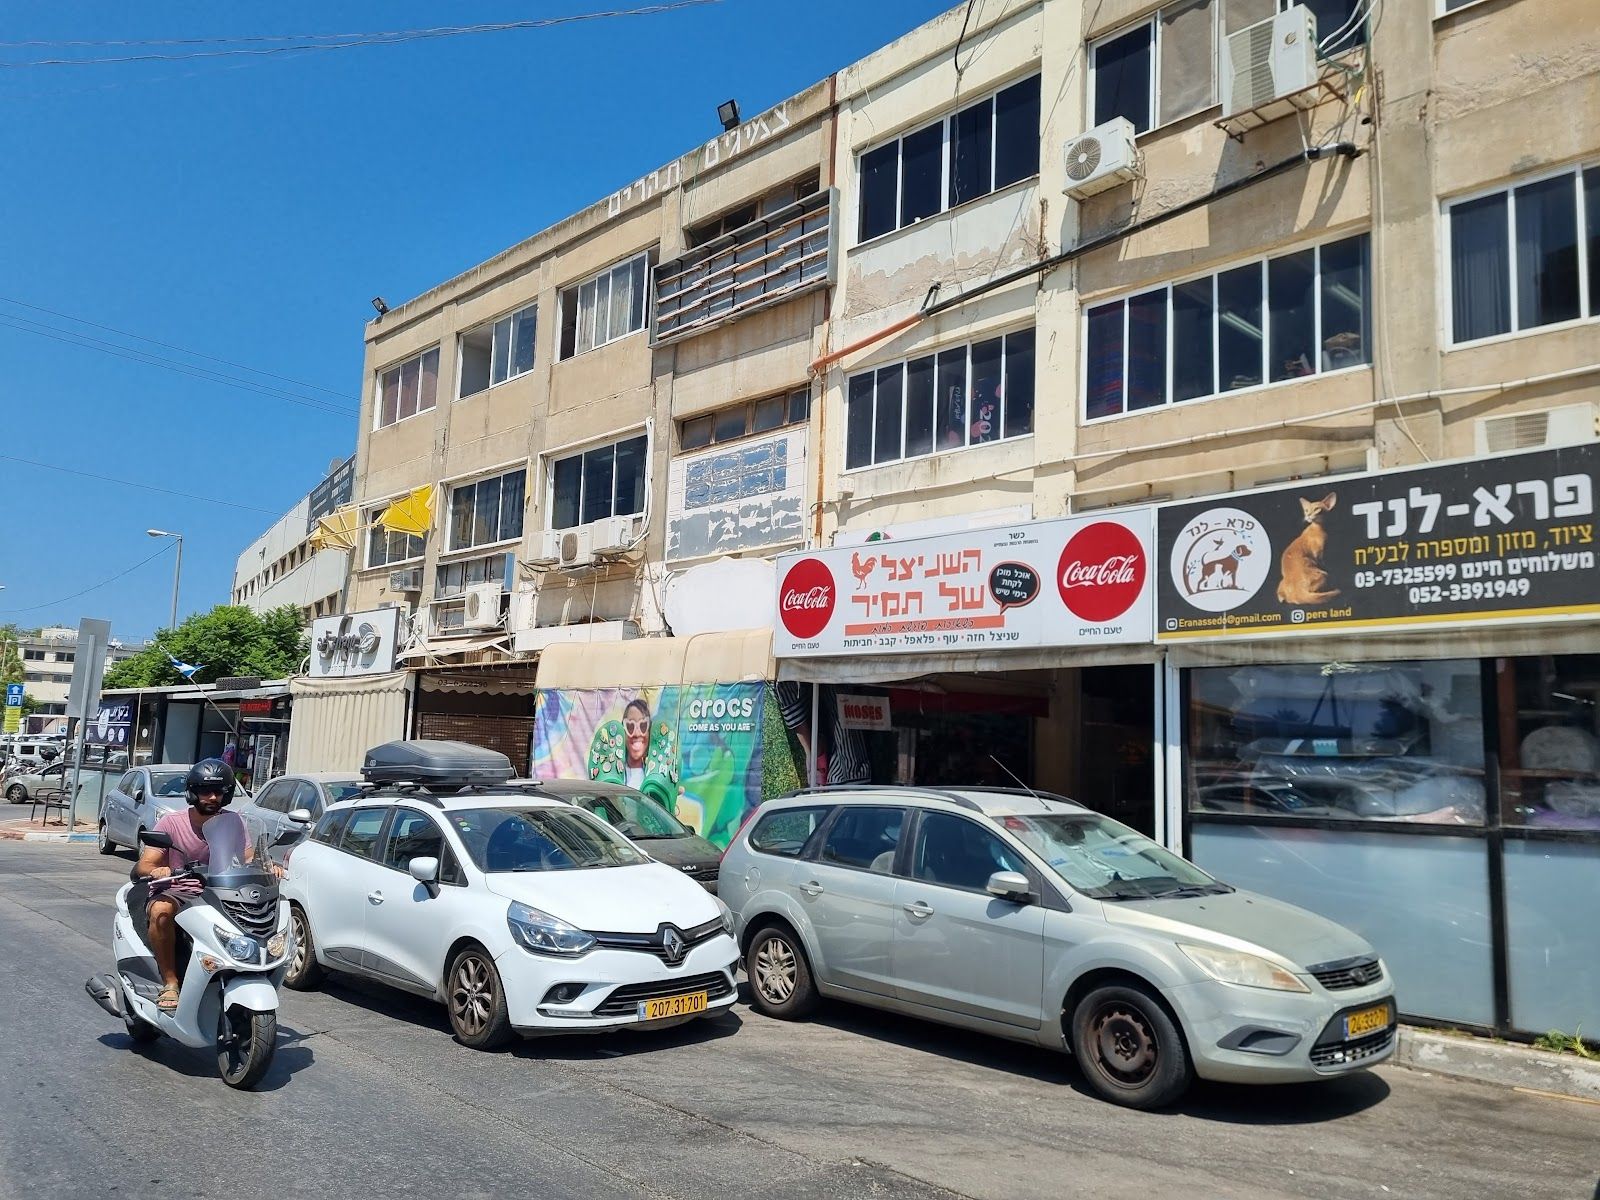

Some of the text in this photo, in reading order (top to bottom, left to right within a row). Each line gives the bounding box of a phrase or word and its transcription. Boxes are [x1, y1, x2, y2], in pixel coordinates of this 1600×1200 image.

[1352, 473, 1594, 540] פרא-לנד
[1185, 521, 1209, 537] לנד
[1226, 518, 1255, 531] פרא
[1008, 531, 1026, 540] כשר
[1498, 530, 1536, 556] מזון
[1542, 524, 1594, 549] ציוד,
[1416, 535, 1490, 559] ומספרה
[881, 549, 982, 582] השניצל
[996, 568, 1031, 580] אוכל מוכן
[1062, 554, 1139, 589] Coca-Cola
[1354, 551, 1595, 588] משלוחים חינם 03-7325599
[1001, 579, 1023, 588] לקחת
[1409, 579, 1530, 604] 052-3391949
[783, 585, 831, 611] Coca-Cola
[852, 582, 985, 618] של תמיר
[1306, 607, 1352, 621] pere land
[843, 630, 1020, 648] שניצל חזה עוף פלאפל קבב חביתות
[1079, 626, 1122, 636] טעם החיים
[689, 698, 753, 718] crocs
[844, 704, 883, 720] MOSES
[688, 723, 709, 732] COME
[709, 723, 719, 731] AS
[721, 723, 736, 732] YOU
